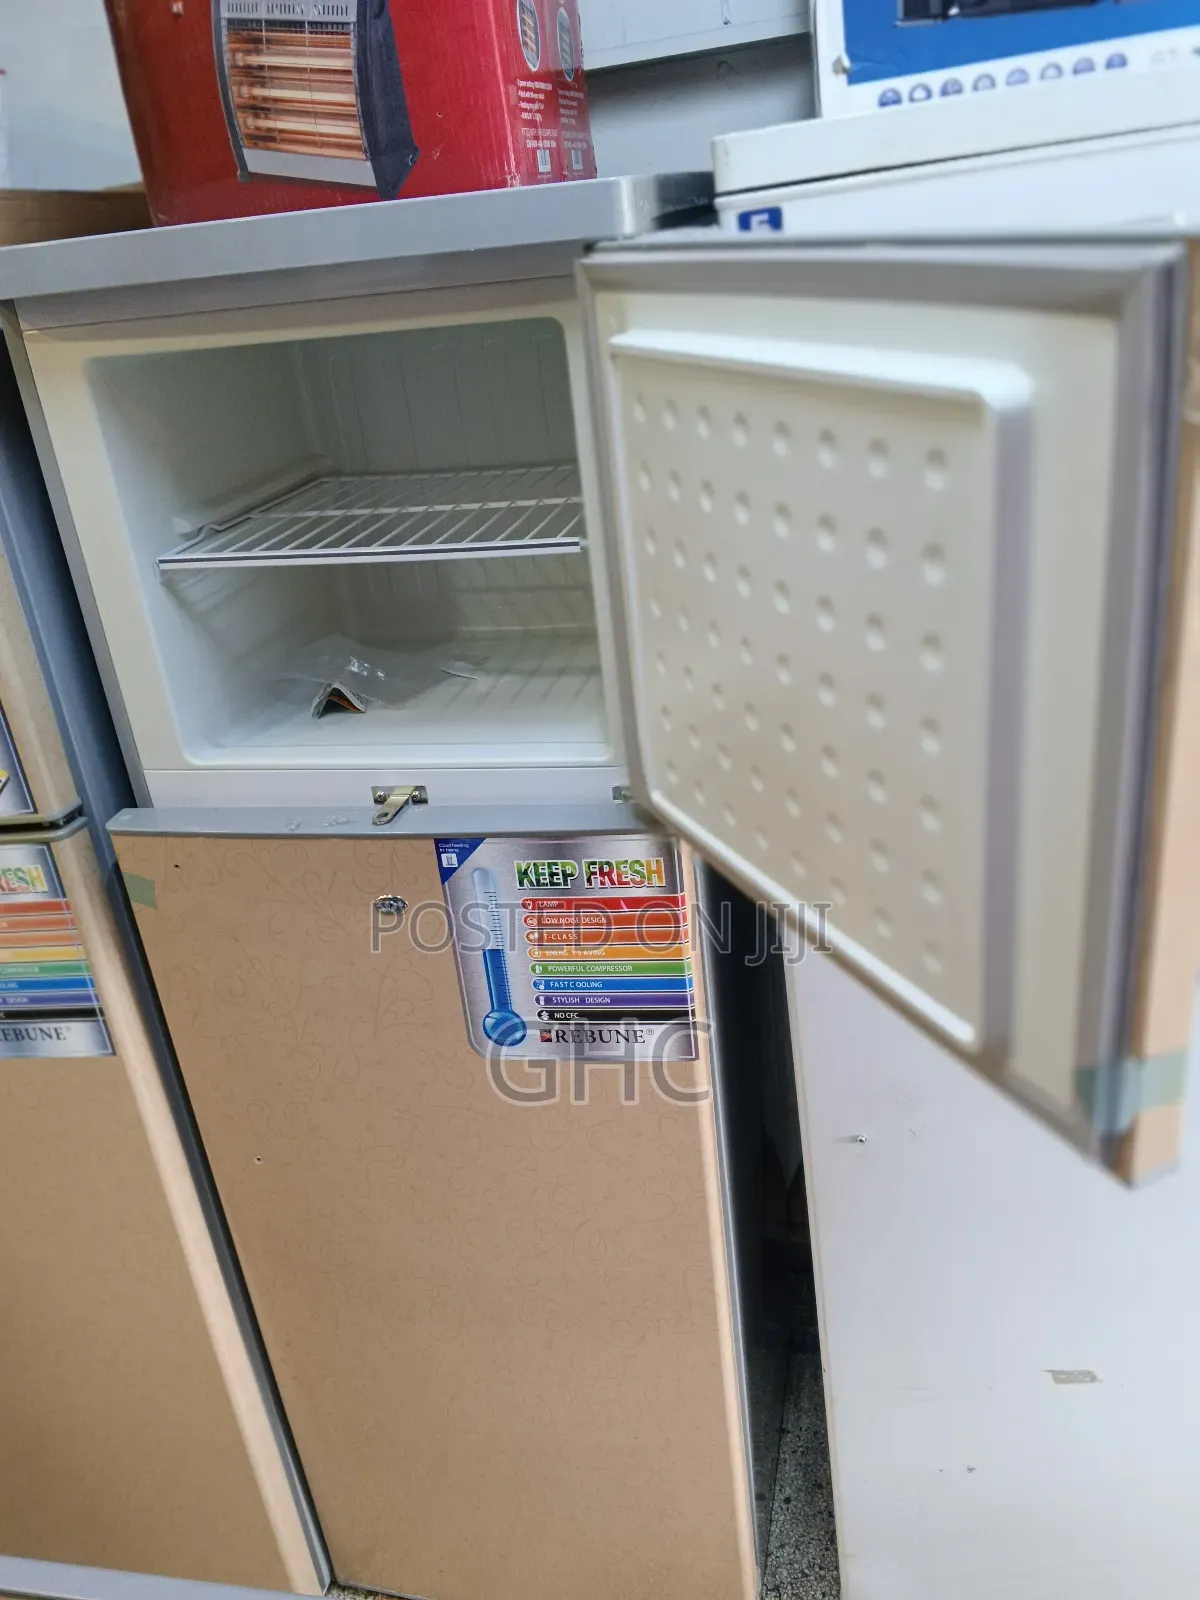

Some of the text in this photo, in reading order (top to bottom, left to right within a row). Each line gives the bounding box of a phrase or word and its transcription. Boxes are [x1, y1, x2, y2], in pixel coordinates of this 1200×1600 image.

[514, 858, 666, 890] KEEP FRESH
[581, 916, 608, 924] DESIGN
[552, 996, 611, 1004] STYLISH DESIGN
